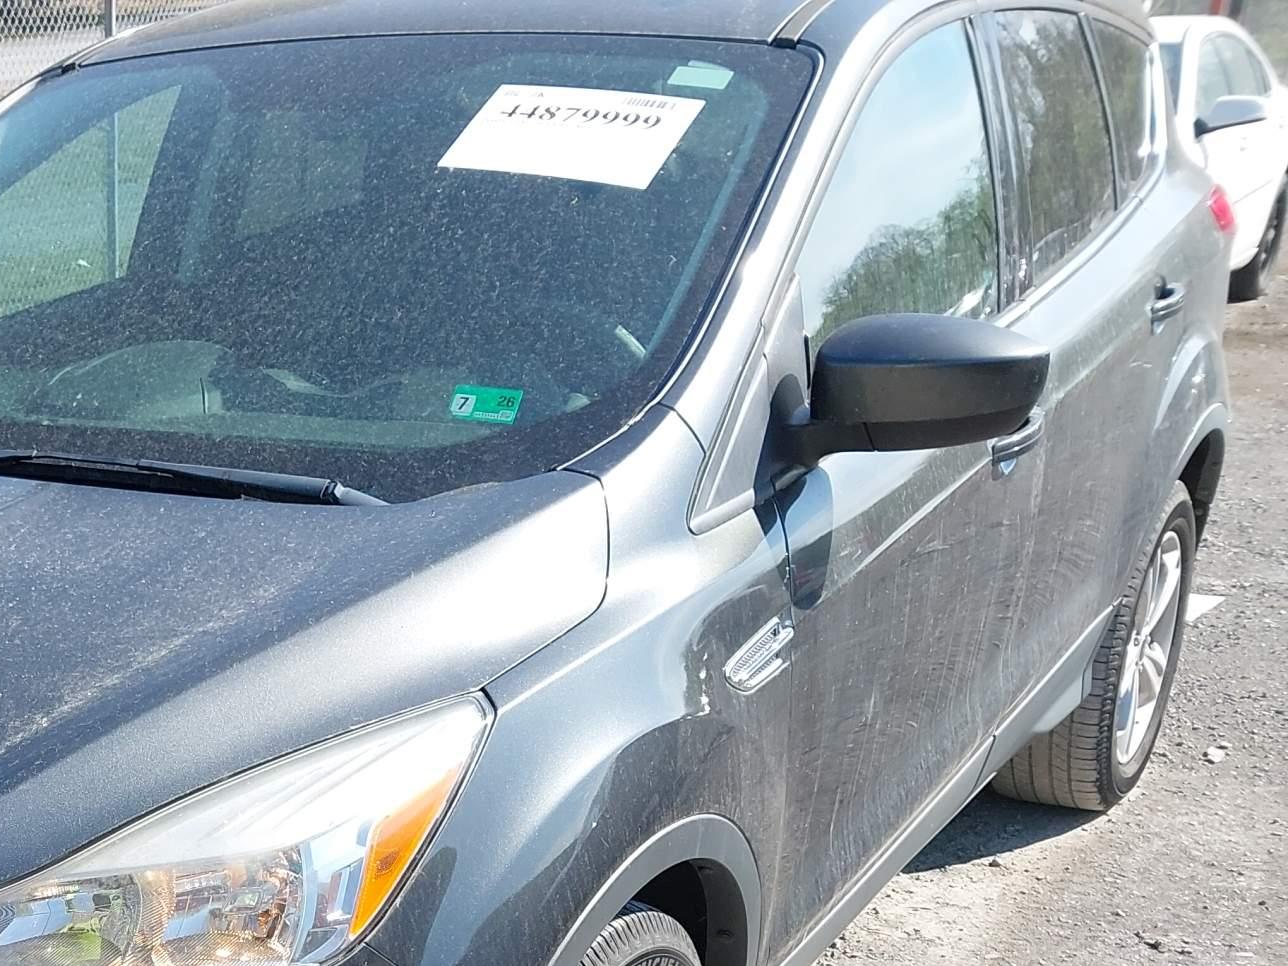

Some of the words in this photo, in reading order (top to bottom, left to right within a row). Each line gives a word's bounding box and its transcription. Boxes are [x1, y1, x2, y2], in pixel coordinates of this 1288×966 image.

[500, 103, 661, 129] 44879999
[457, 396, 470, 411] 7
[496, 394, 516, 409] 26
